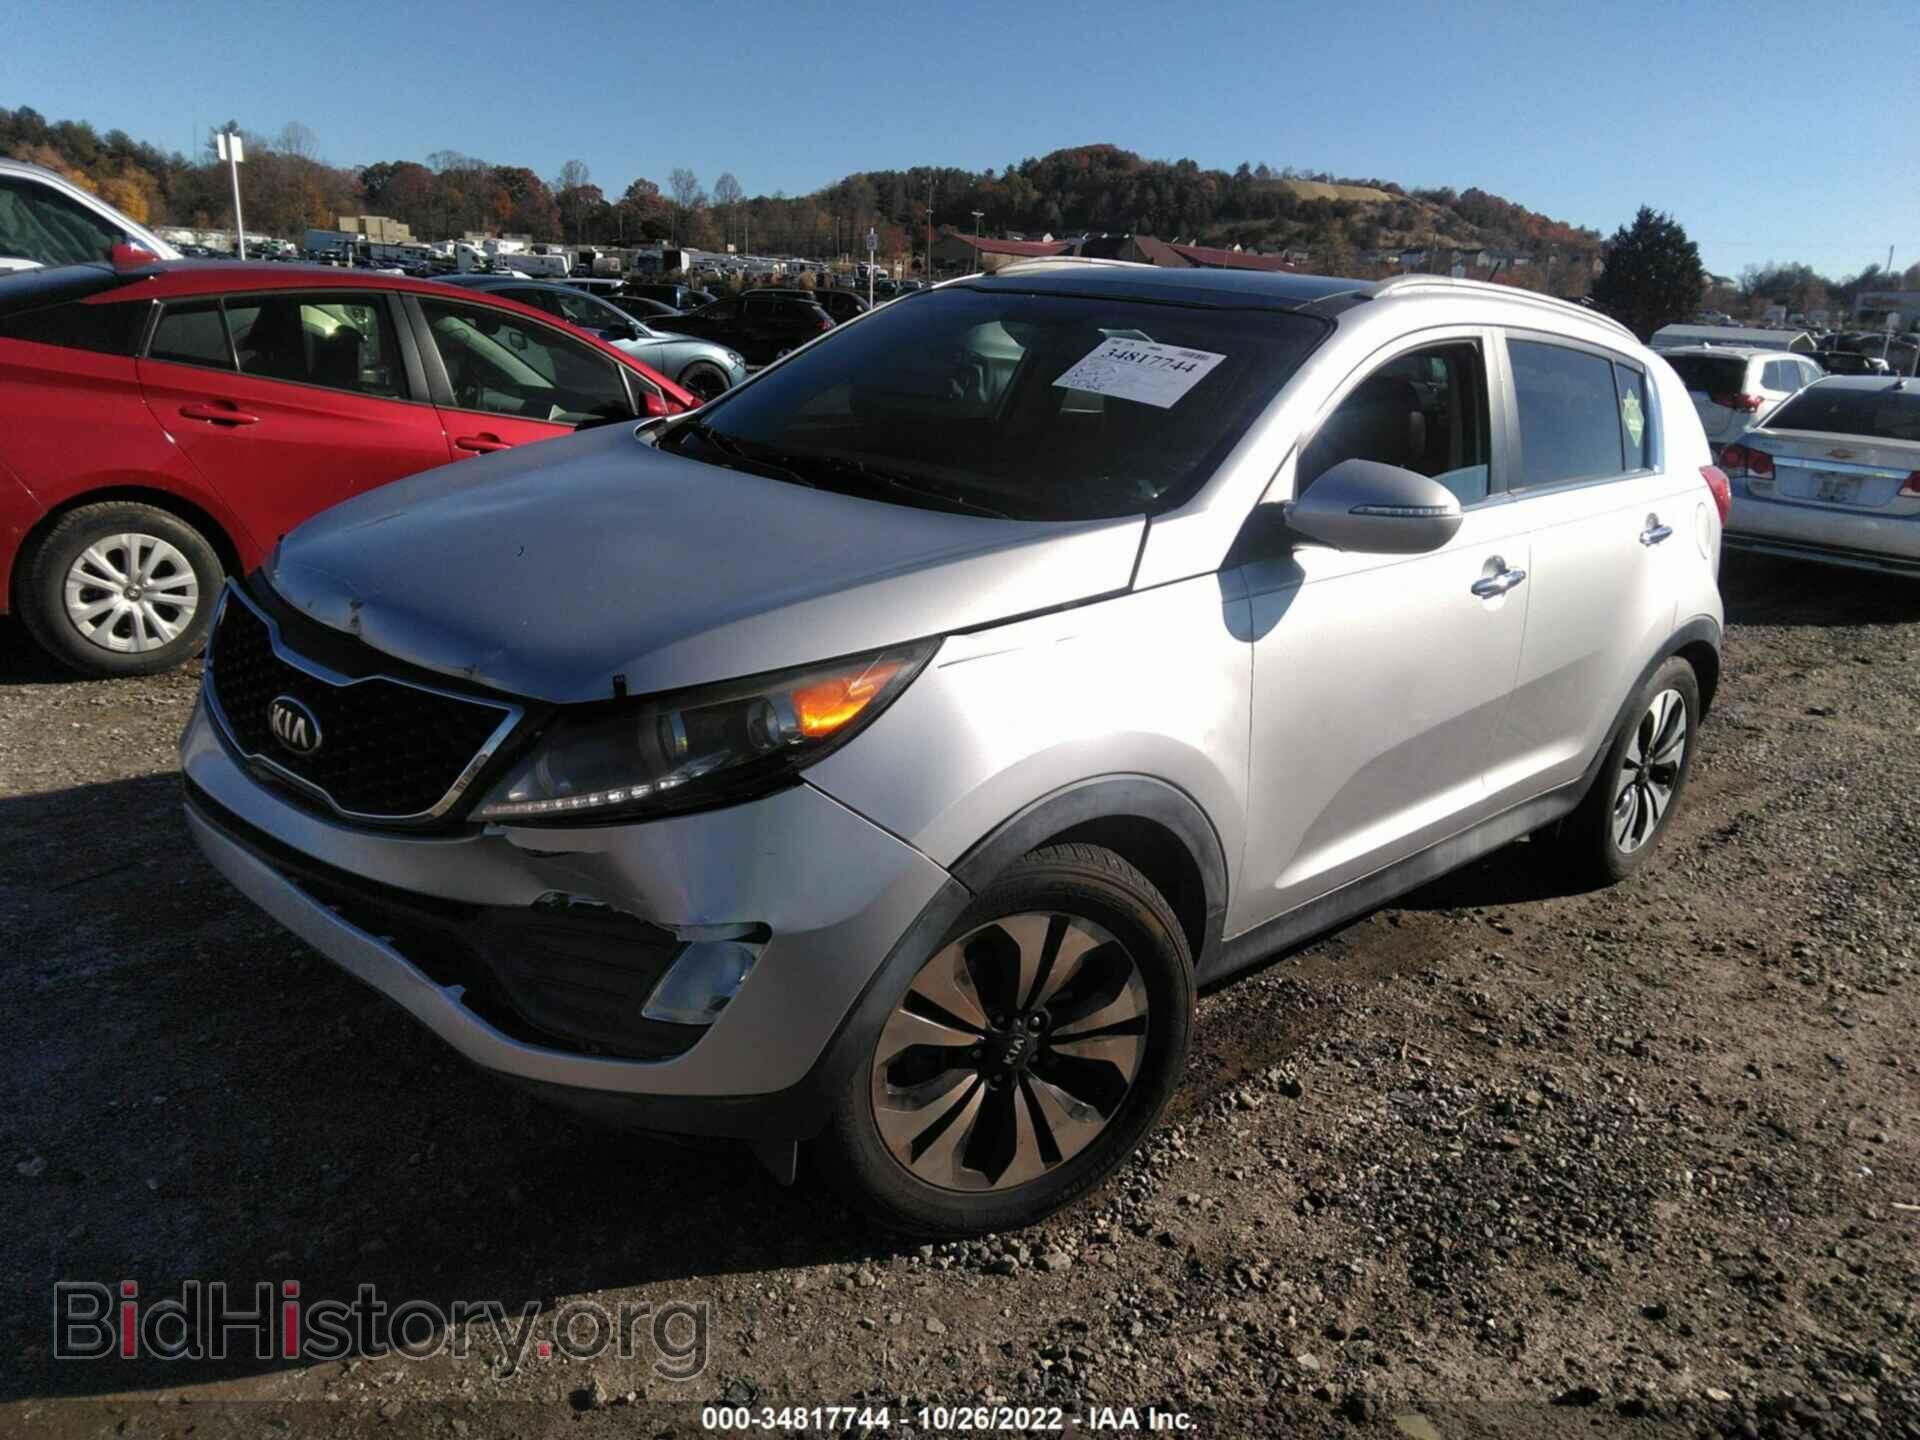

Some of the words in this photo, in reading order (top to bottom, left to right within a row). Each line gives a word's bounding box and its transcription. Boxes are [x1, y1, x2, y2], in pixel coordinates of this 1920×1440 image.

[1101, 348, 1197, 373] 34817744
[272, 703, 309, 749] KIA
[1002, 1039, 1025, 1065] KIA
